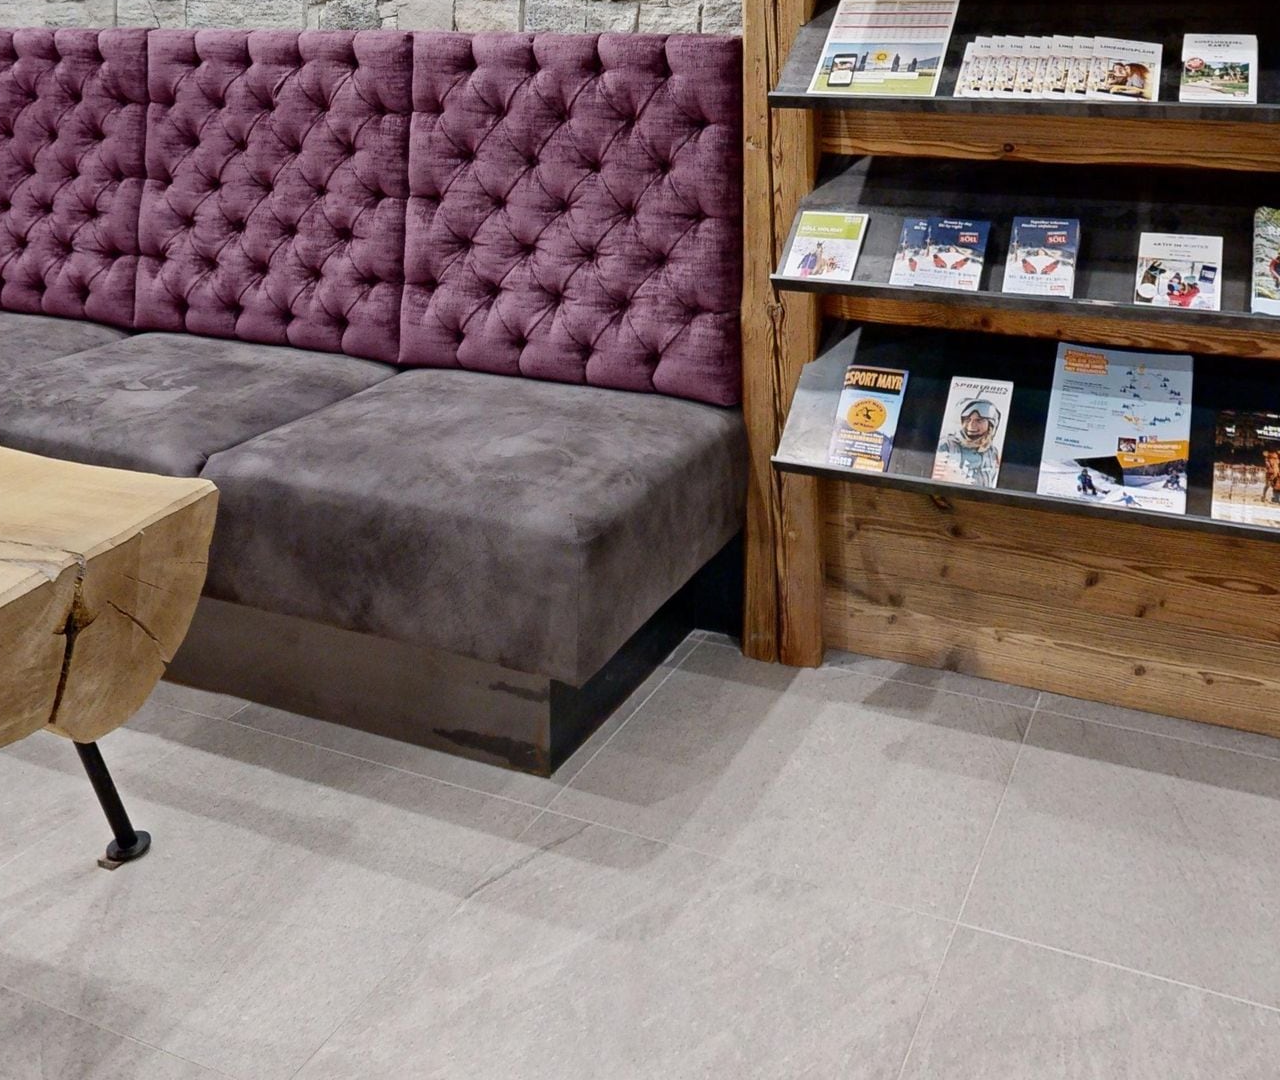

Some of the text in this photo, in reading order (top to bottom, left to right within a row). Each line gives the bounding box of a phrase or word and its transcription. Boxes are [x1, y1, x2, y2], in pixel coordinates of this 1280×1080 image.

[959, 235, 977, 243] SÖLL
[1048, 235, 1066, 243] SÖLL
[847, 371, 903, 390] SPORT MAYR
